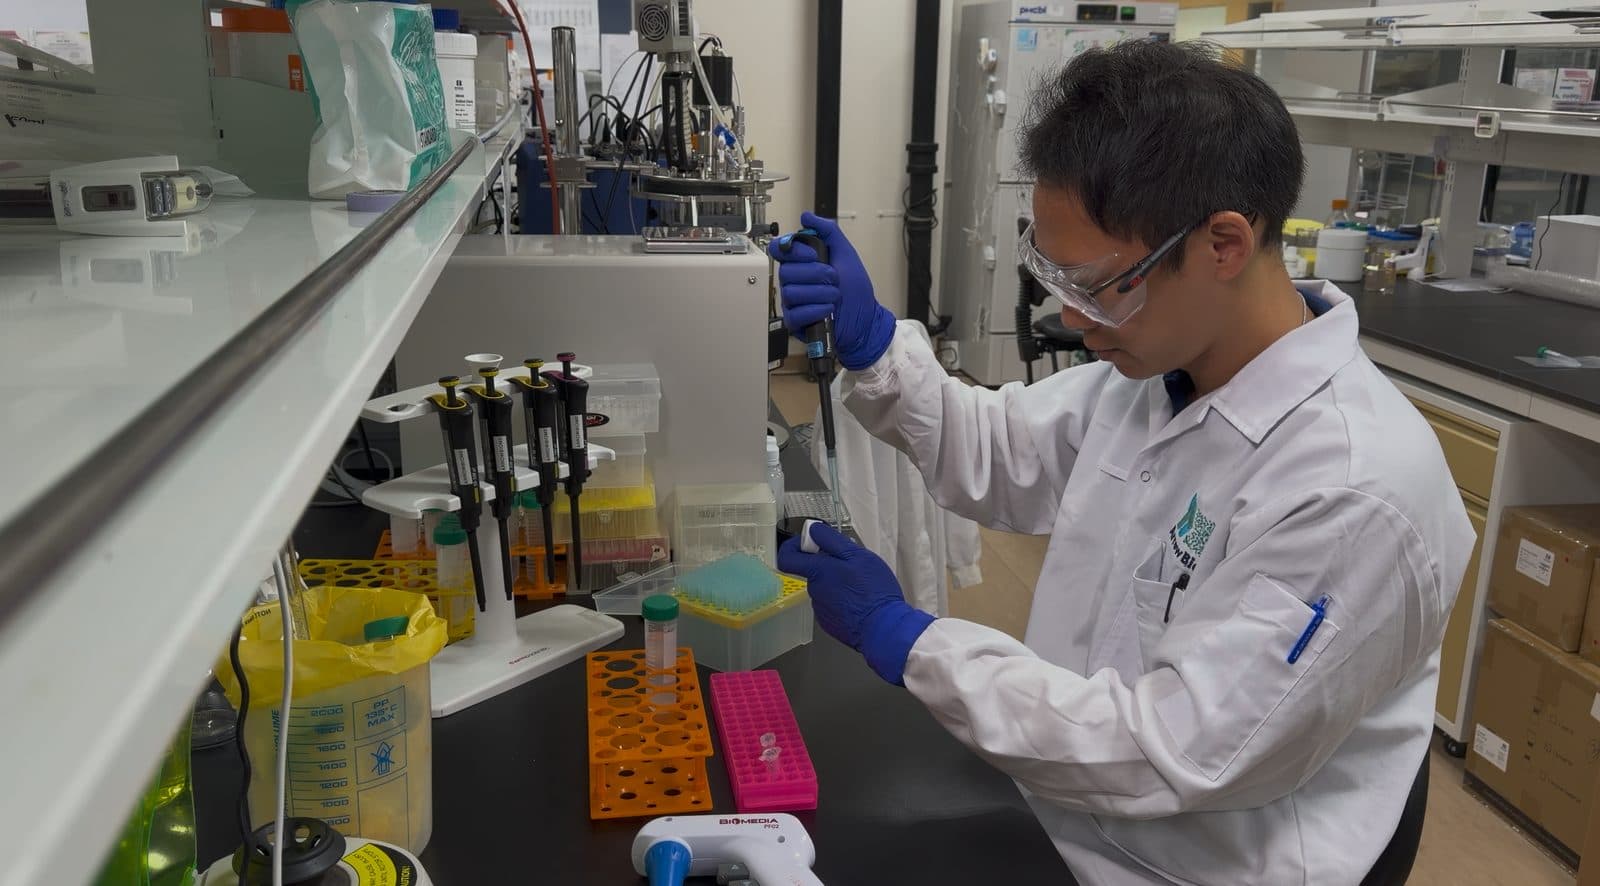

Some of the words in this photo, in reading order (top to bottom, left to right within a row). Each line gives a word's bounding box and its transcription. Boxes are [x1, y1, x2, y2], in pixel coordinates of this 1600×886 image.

[373, 698, 389, 710] PP
[311, 707, 344, 718] 2000
[368, 712, 394, 728] MAX
[316, 743, 346, 753] 1600
[319, 761, 347, 771] 1400
[320, 780, 348, 789] 1200
[321, 799, 349, 808] 1000
